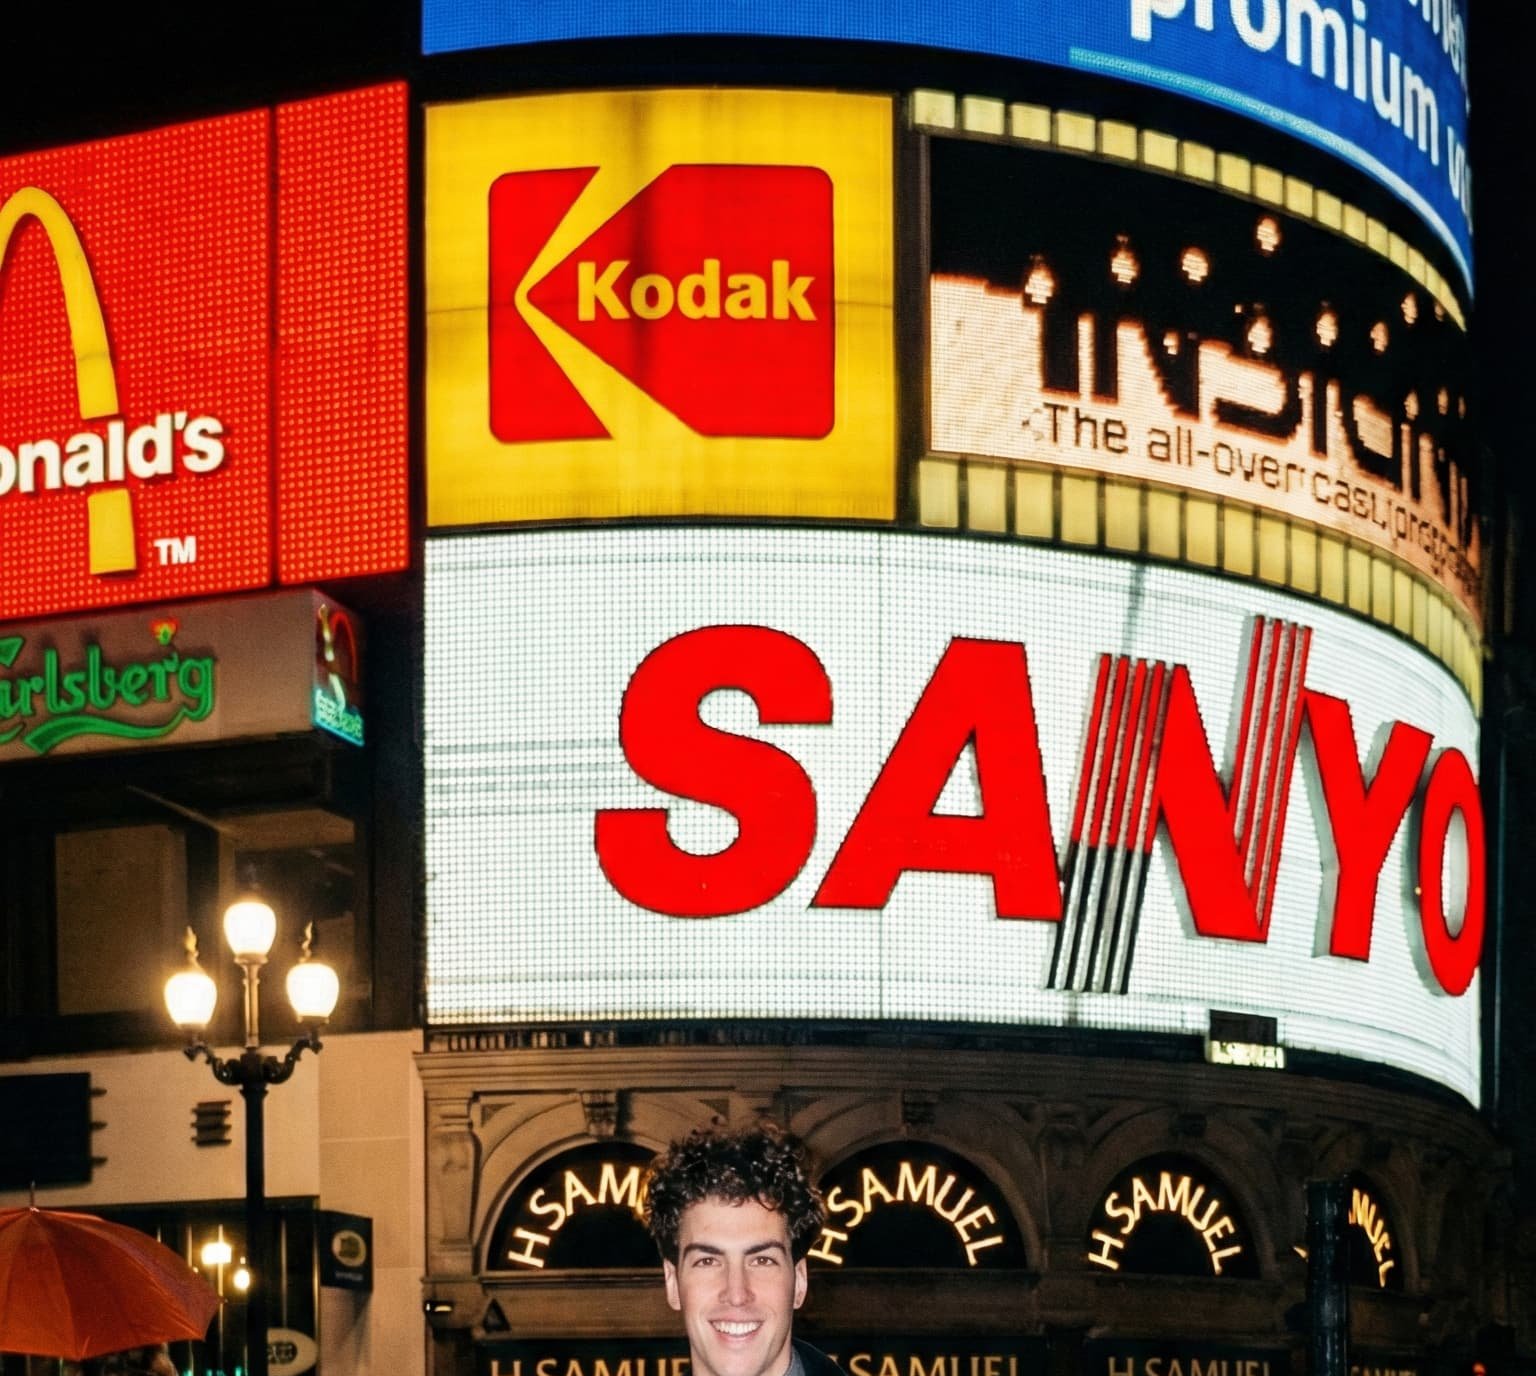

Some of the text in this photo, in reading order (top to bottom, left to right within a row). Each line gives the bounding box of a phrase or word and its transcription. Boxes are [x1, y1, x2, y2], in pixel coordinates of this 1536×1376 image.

[578, 258, 817, 322] Kodak
[1043, 402, 1128, 454] The
[154, 536, 197, 565] TM
[594, 614, 1485, 996] SANYO
[507, 1227, 551, 1268] H
[807, 1161, 1003, 1266] H SAMUEL
[1088, 1171, 1242, 1275] H SAMUEL
[1348, 1187, 1394, 1288] MUEL
